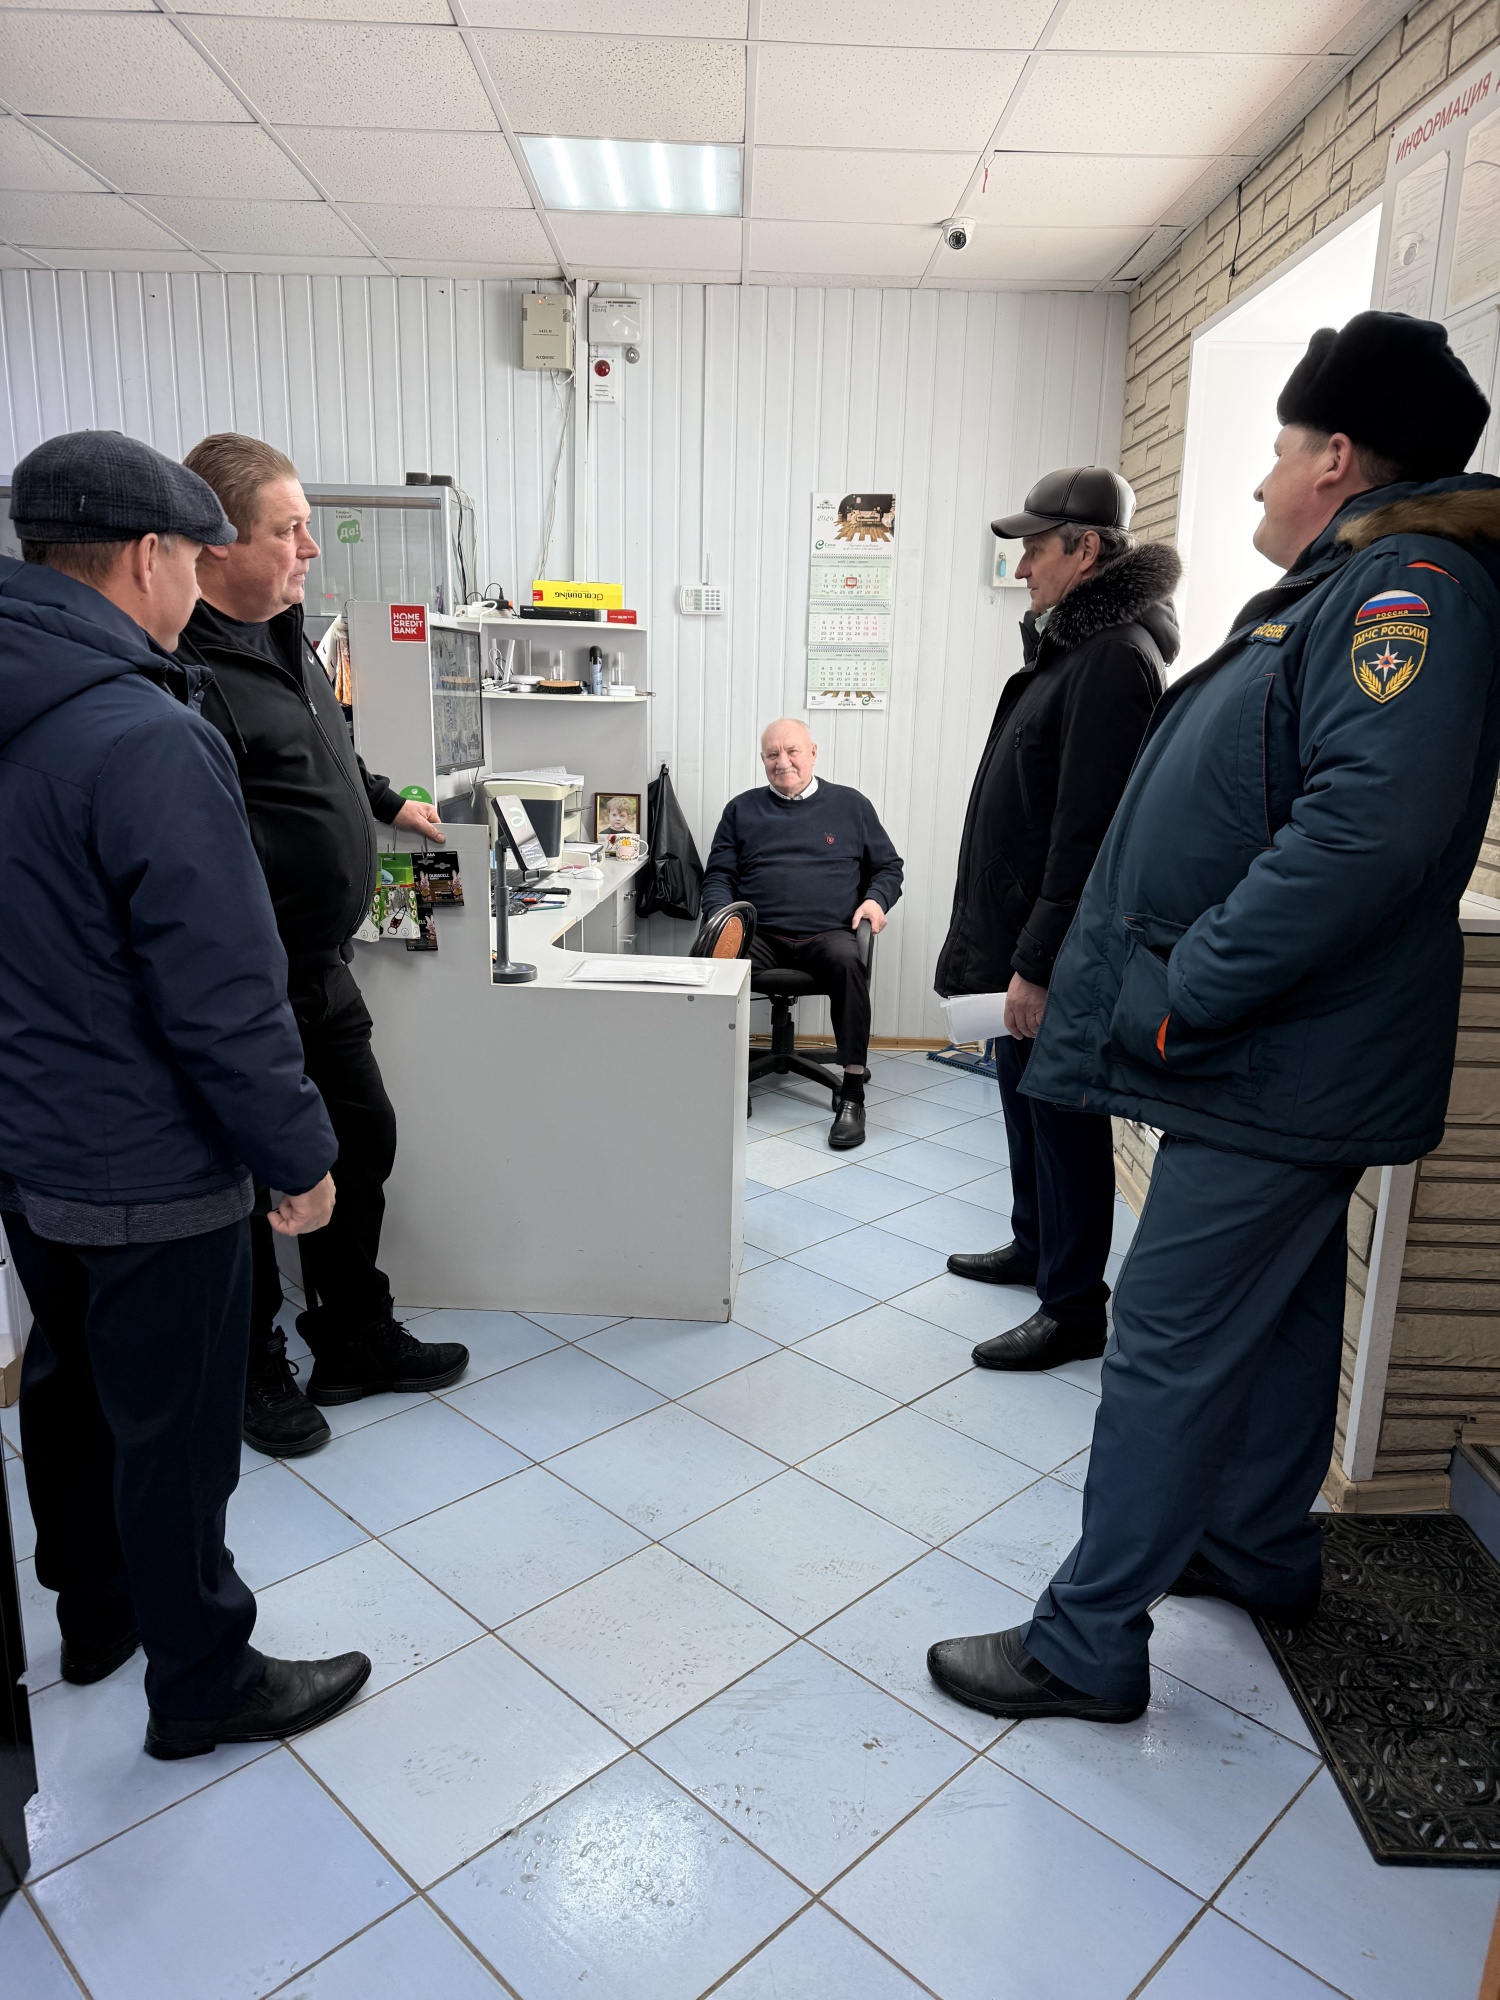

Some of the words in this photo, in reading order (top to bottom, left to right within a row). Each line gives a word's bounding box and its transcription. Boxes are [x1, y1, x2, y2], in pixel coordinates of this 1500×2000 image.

[1395, 71, 1492, 165] ИНФОРМАЦИЯ
[340, 524, 360, 540] Да!
[393, 612, 420, 620] HOME
[1376, 610, 1408, 618] РОССИЯ
[394, 620, 424, 628] CREDIT
[1356, 629, 1378, 645] МЧС
[1381, 626, 1424, 640] РОССИИ
